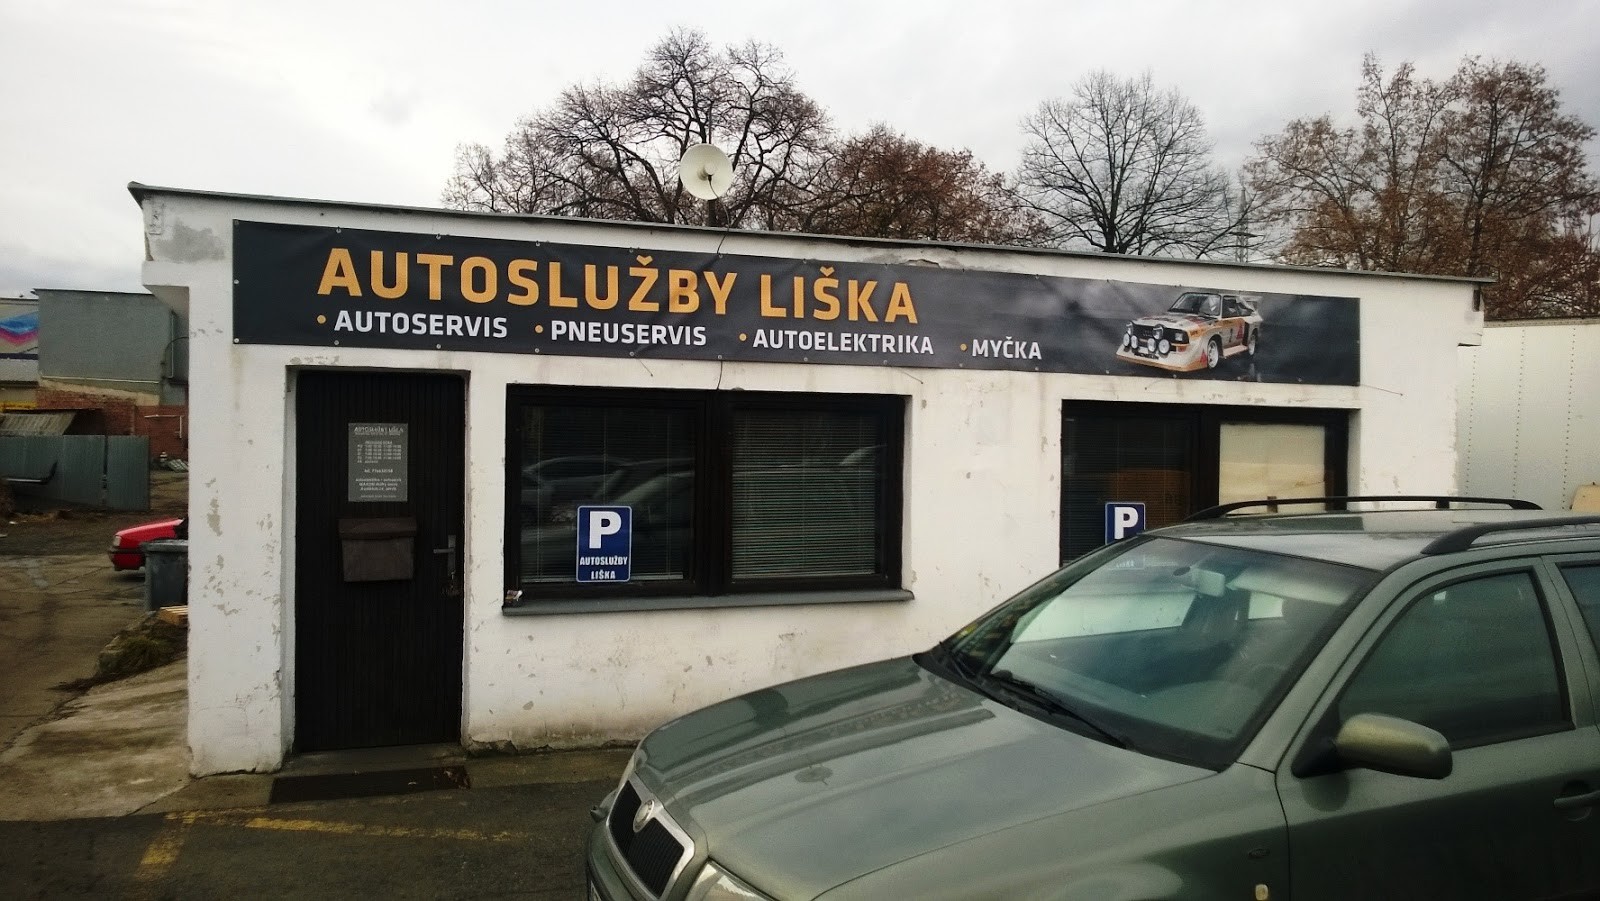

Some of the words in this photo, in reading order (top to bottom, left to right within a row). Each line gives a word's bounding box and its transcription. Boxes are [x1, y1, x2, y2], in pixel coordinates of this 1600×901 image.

[318, 248, 738, 315] AUTOSLUŽBY
[759, 267, 918, 324] LIŠKA
[334, 309, 509, 339] AUTOSERVIS
[550, 320, 707, 347] PNEUSERVIS
[752, 328, 935, 355] AUTOELEKTRIKA
[971, 336, 1043, 360] MYČKA
[589, 511, 622, 549] P
[1114, 506, 1139, 540] P
[580, 555, 628, 566] AUTOSLUŽBY
[590, 568, 616, 580] LIŠKA
